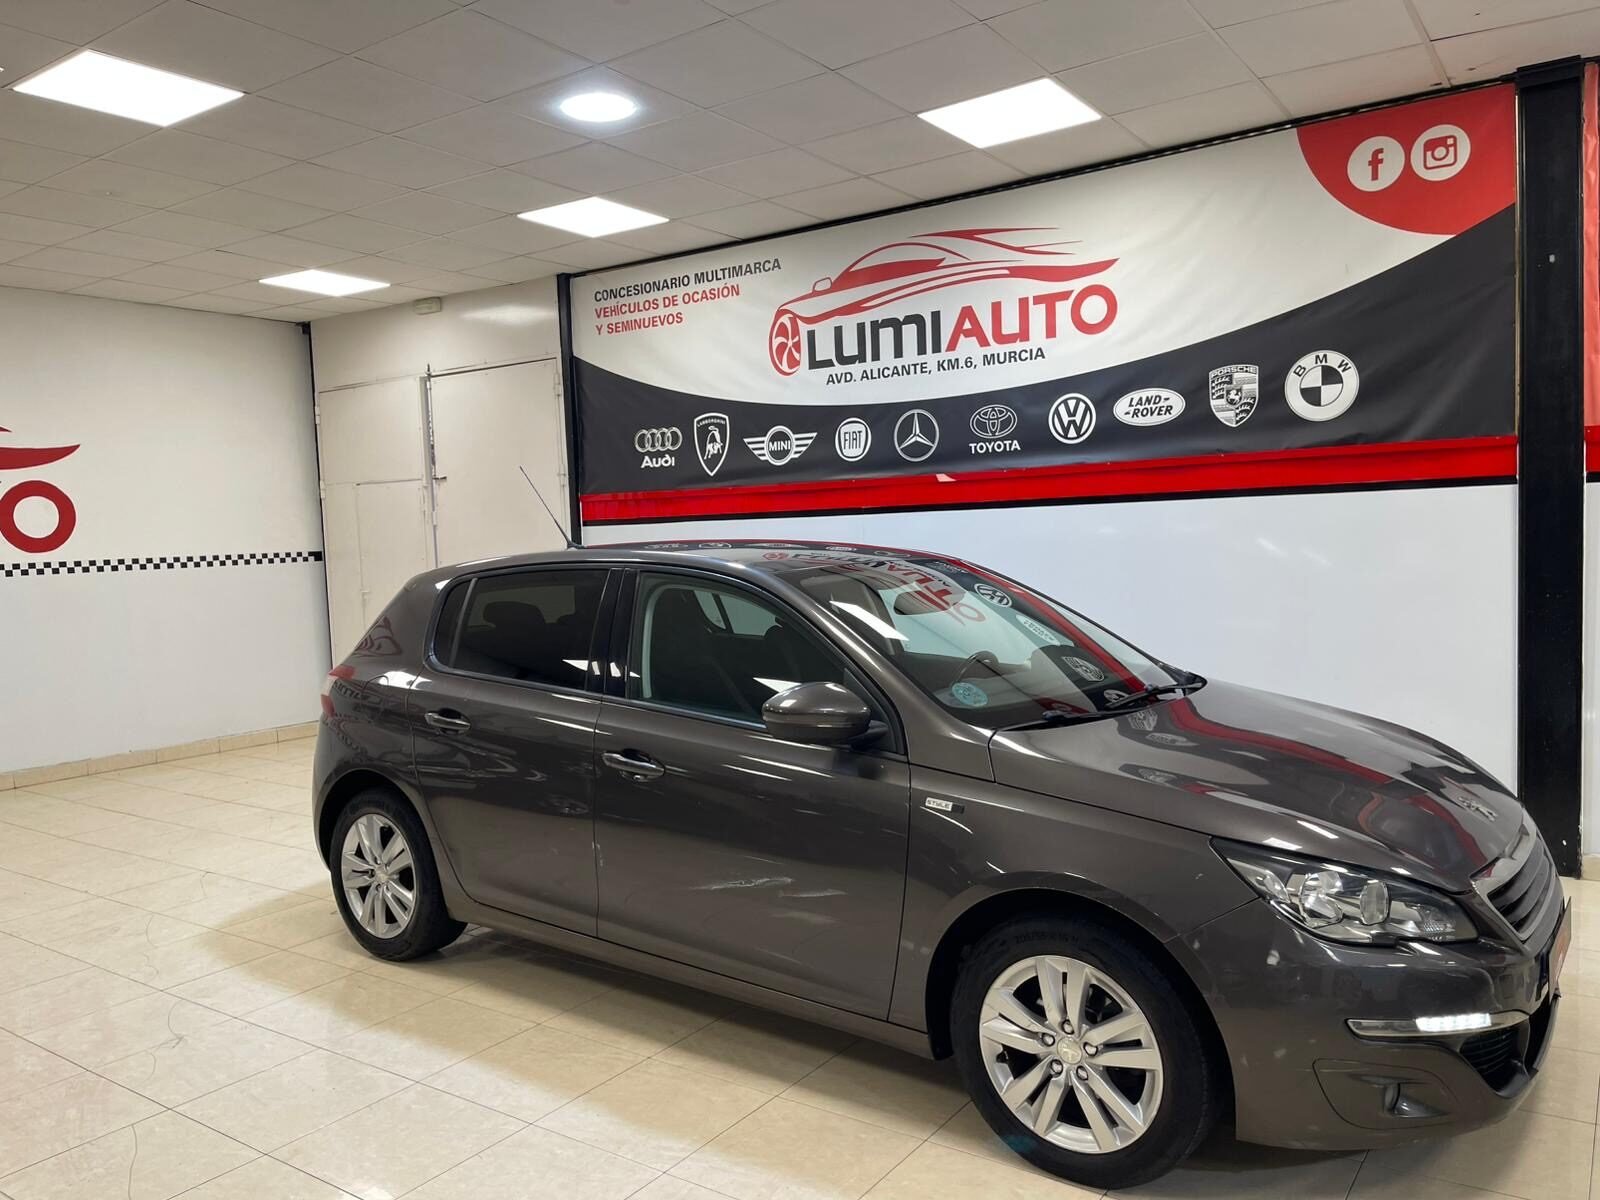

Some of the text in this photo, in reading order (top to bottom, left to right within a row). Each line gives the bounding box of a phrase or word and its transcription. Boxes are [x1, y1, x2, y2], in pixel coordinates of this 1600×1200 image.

[594, 258, 782, 302] CONCESIONARIO MULTIMARCA
[594, 283, 740, 319] VEHÍCULOS DE OCASIÓN
[595, 312, 684, 336] Y SEMINUEVOS
[825, 347, 1046, 386] AVD. ALICANTE, KM.6, MURCIA
[1210, 365, 1258, 379] PORSCHE
[1293, 353, 1352, 377] BMW
[768, 440, 791, 452] MINI
[843, 430, 863, 450] FIAT
[968, 439, 1021, 455] TOYOTA
[640, 454, 675, 469] Audi
